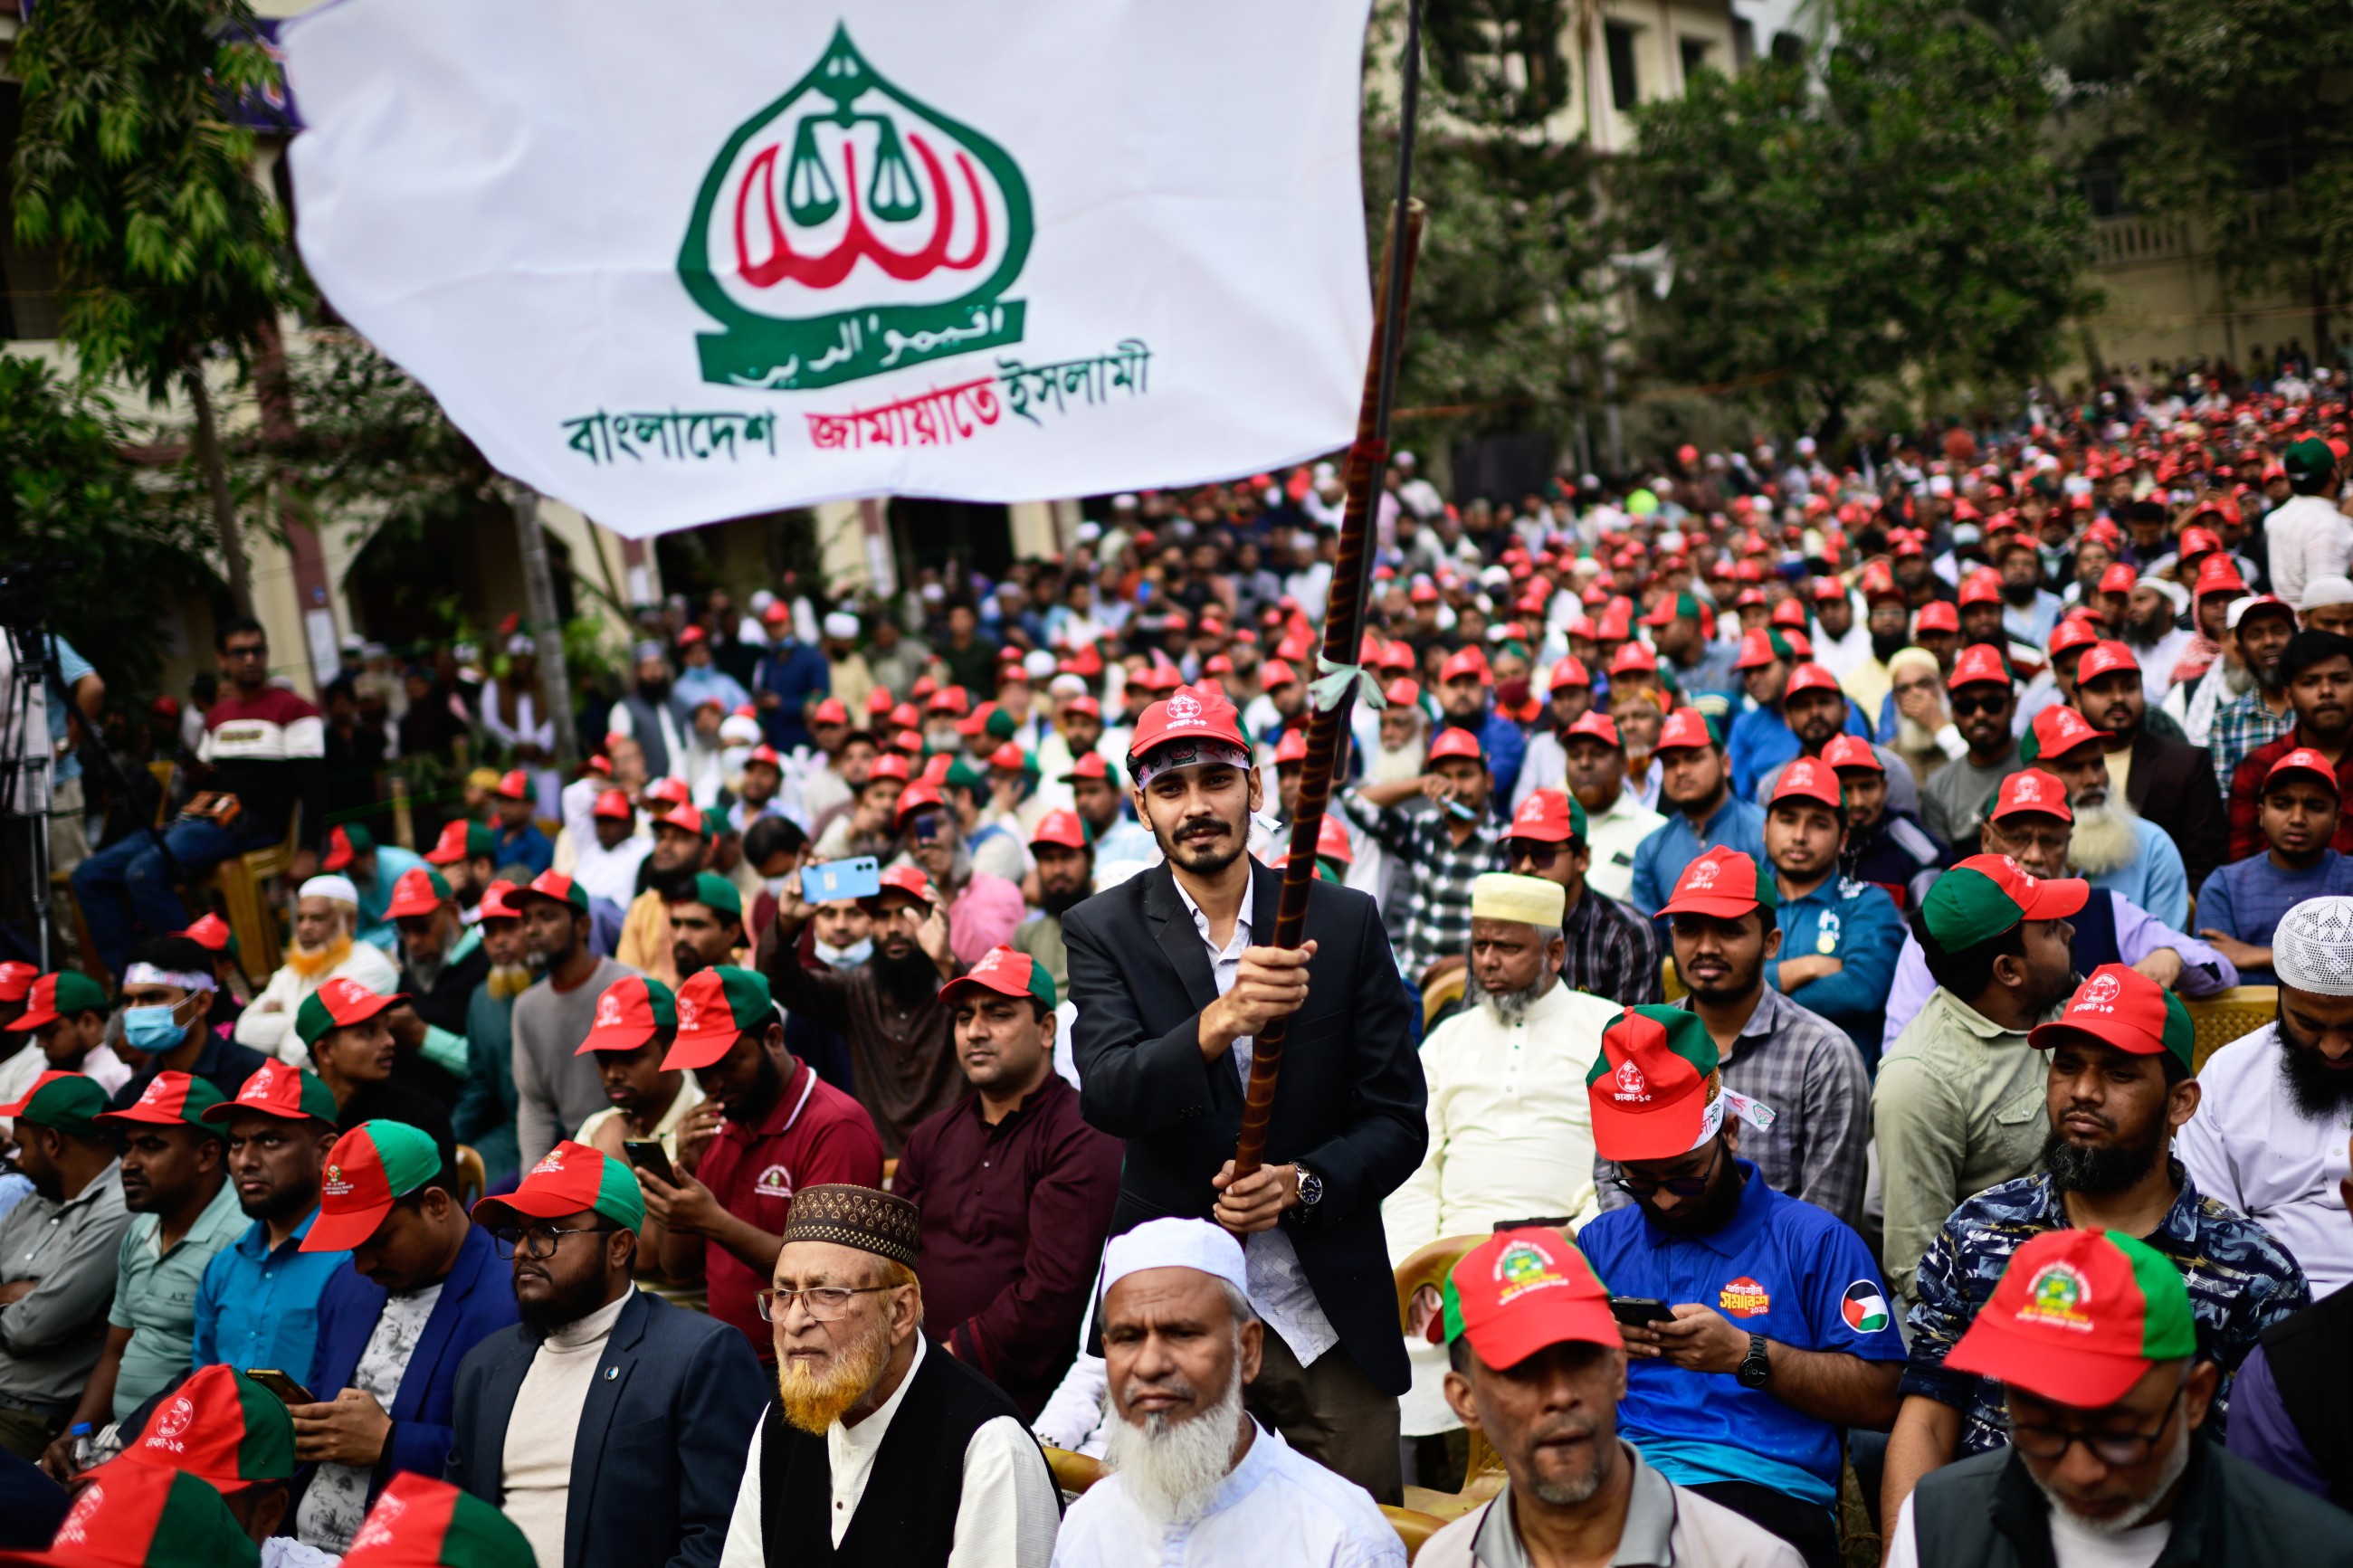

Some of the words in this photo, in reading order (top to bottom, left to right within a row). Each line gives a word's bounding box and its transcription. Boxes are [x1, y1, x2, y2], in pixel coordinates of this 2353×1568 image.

[561, 407, 778, 464] বাংলাদেশ
[804, 376, 1003, 450] জামায়াতে
[996, 338, 1153, 427] ইসলামী
[1614, 1092, 1653, 1102] ঢাকা-১৫
[1720, 1291, 1769, 1311] সমাবেশ
